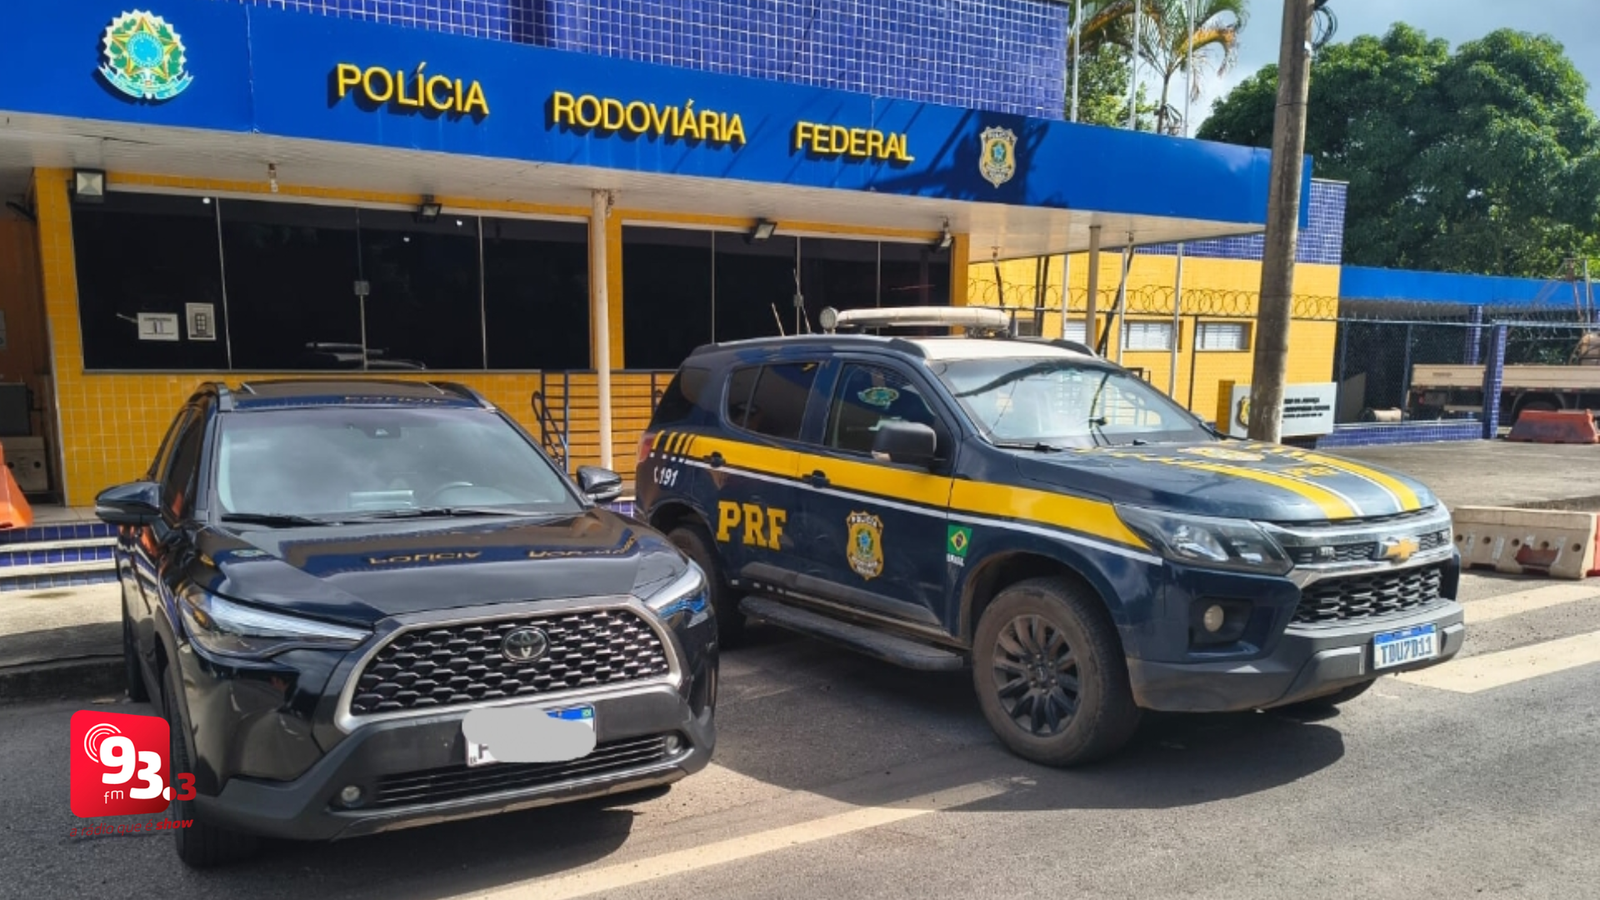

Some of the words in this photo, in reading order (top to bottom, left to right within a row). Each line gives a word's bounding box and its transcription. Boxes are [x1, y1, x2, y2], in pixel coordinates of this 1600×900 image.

[337, 61, 490, 115] POLÍCIA
[553, 91, 747, 145] RODOVIÁRIA
[796, 121, 915, 161] FEDERAL
[659, 466, 679, 487] 191
[716, 500, 787, 551] PRF
